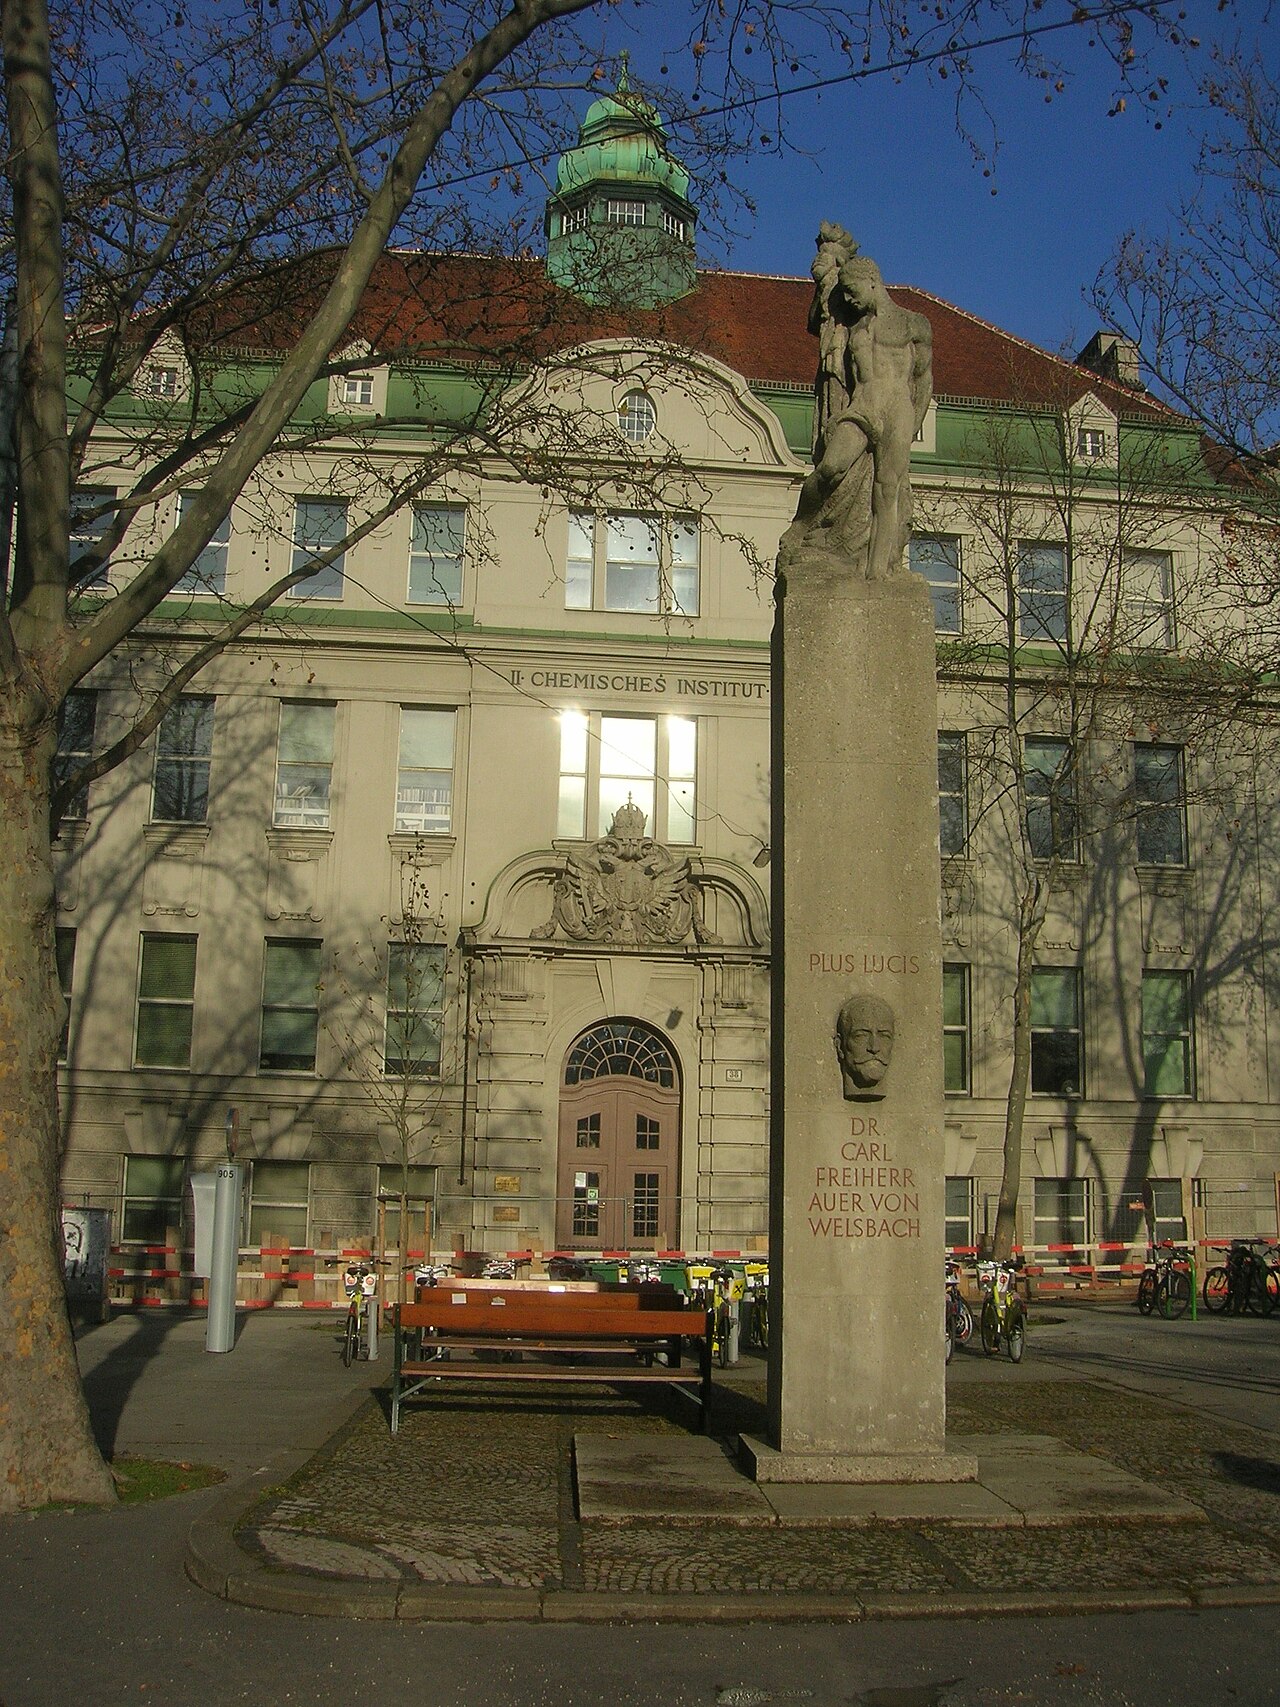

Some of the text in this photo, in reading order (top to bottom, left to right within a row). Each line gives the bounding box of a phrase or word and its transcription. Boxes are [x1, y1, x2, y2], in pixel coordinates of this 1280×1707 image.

[531, 672, 667, 694] CHEMISCHES
[809, 953, 920, 974] PLUS LUCIS
[851, 1117, 887, 1137] DR.
[841, 1142, 892, 1162] CARL
[217, 1169, 234, 1179] 905
[816, 1167, 916, 1188] FREIHERR
[808, 1192, 919, 1213] AUER VON
[808, 1217, 921, 1238] WELSBACH
